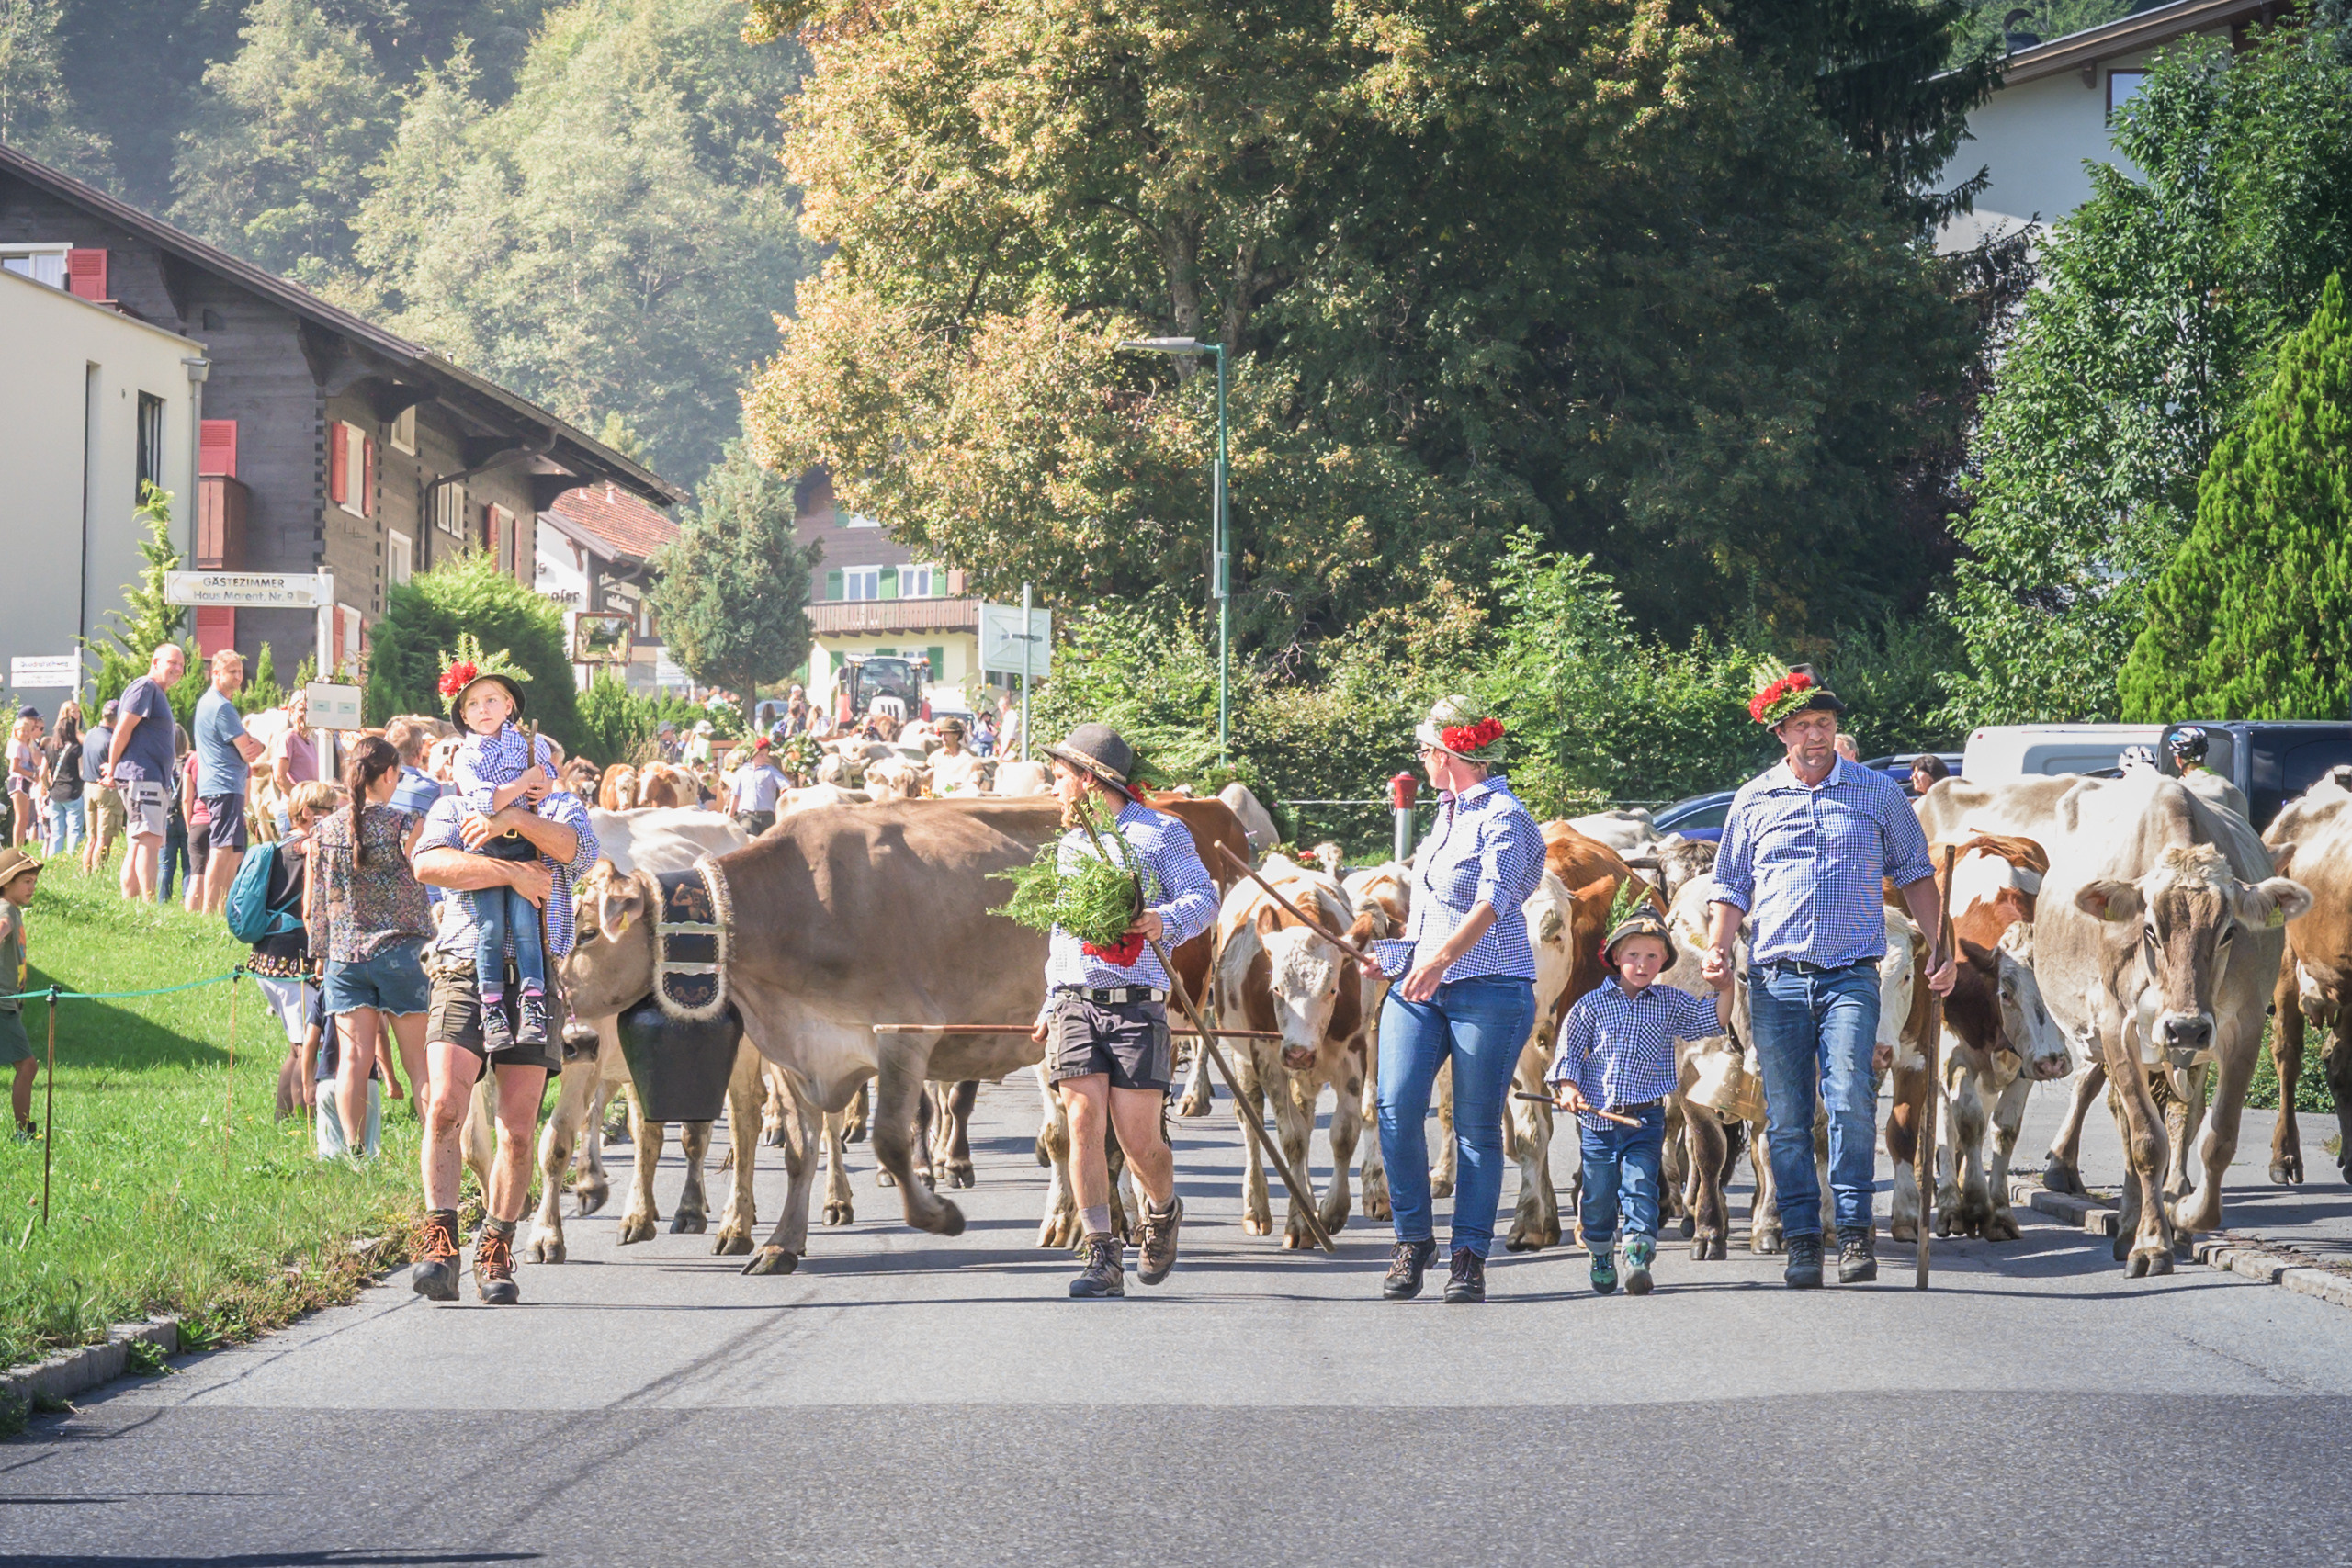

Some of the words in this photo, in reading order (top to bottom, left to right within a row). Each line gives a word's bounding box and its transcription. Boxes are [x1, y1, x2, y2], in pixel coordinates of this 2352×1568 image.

[202, 576, 285, 589] GÄSTEZIMMER
[193, 591, 220, 600] Haus
[268, 592, 285, 602] Nr.
[287, 592, 294, 600] 9
